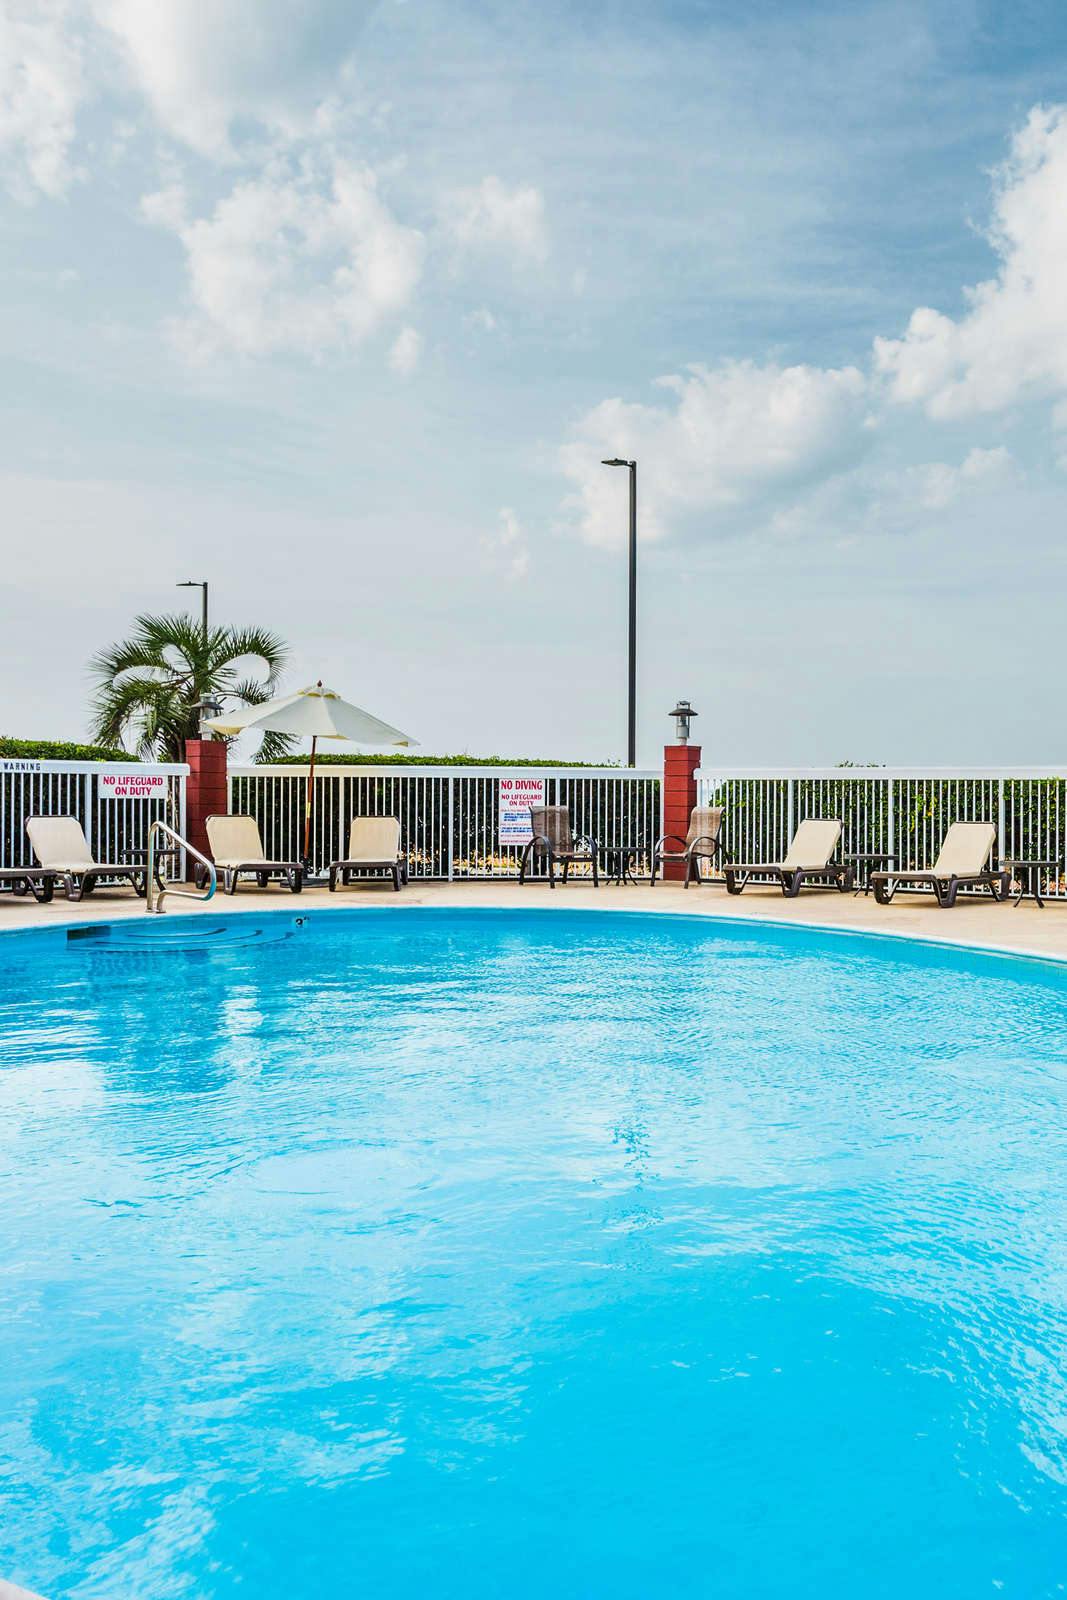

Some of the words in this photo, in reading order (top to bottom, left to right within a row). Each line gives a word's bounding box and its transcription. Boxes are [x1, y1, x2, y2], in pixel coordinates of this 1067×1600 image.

[3, 762, 41, 771] WARNING
[103, 776, 116, 785] NO
[118, 776, 163, 786] LIFEGUARD
[501, 780, 513, 790] NO
[515, 780, 543, 790] DIVING
[115, 787, 127, 795] ON
[130, 787, 152, 796] DUTY
